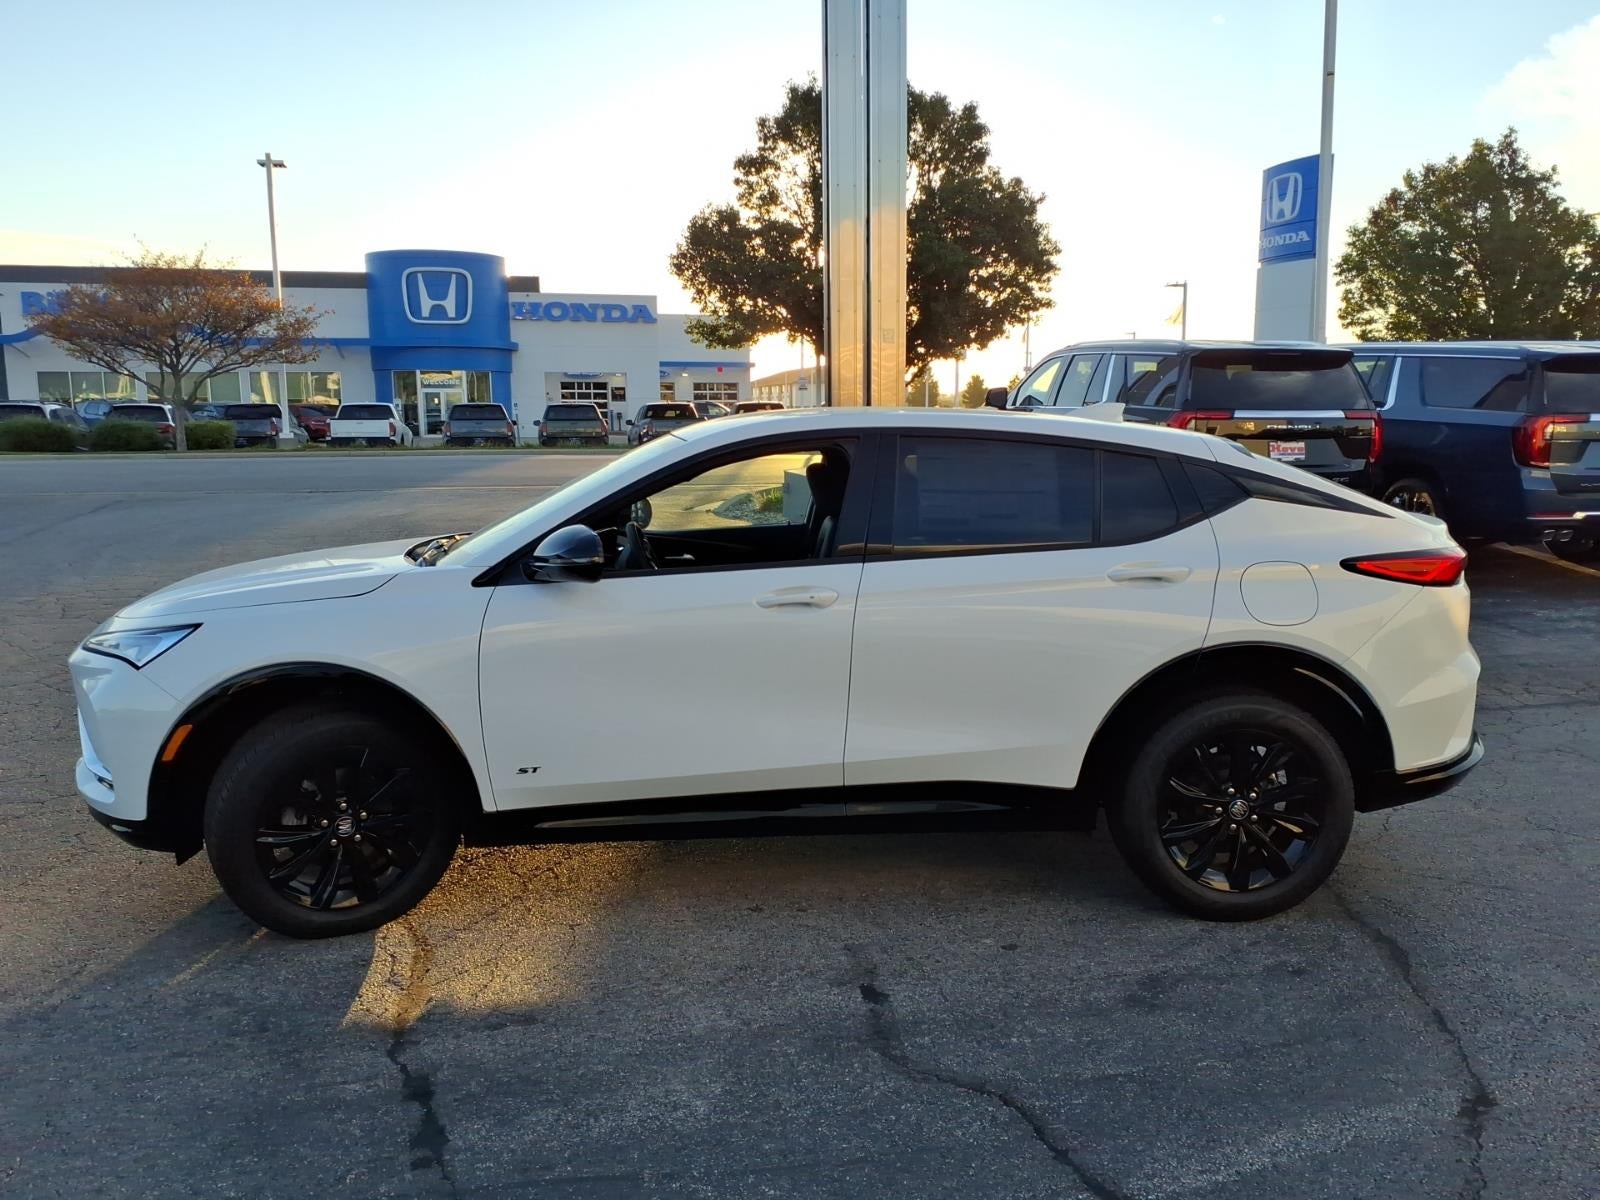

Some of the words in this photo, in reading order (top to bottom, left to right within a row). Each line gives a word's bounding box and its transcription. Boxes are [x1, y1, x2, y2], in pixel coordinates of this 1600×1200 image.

[1260, 230, 1310, 248] HONDA
[511, 301, 657, 324] HONDA
[515, 766, 542, 775] ST
